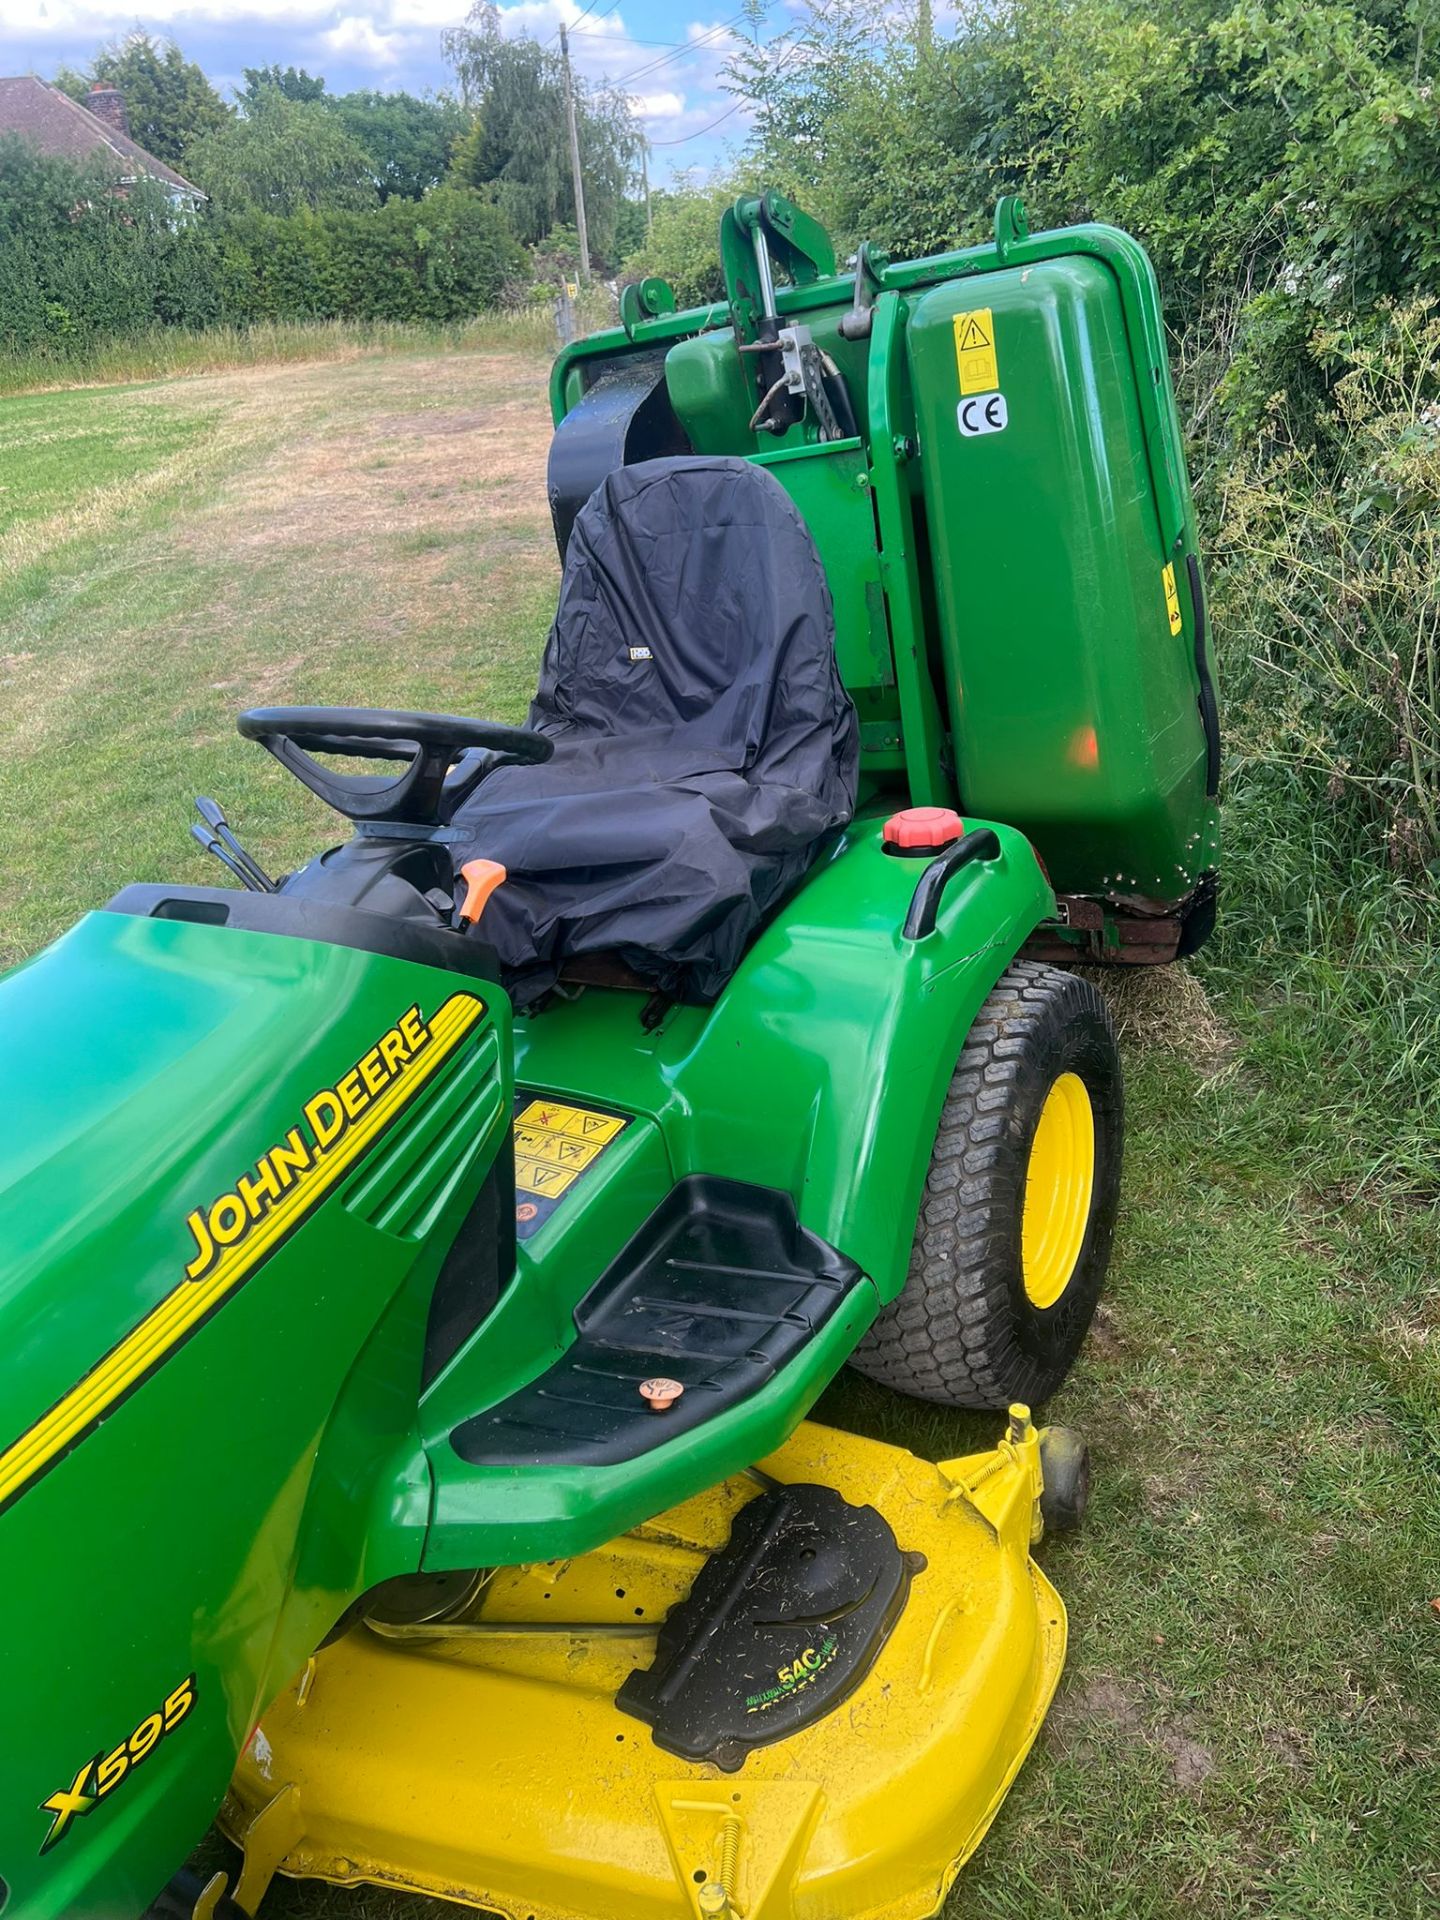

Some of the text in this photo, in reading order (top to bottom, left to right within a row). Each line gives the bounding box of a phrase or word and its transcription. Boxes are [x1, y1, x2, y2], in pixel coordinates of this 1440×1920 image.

[962, 396, 1002, 431] CE
[185, 1004, 430, 1281] JOHN DEERE
[777, 1648, 821, 1690] 54C
[40, 1675, 195, 1852] X595
